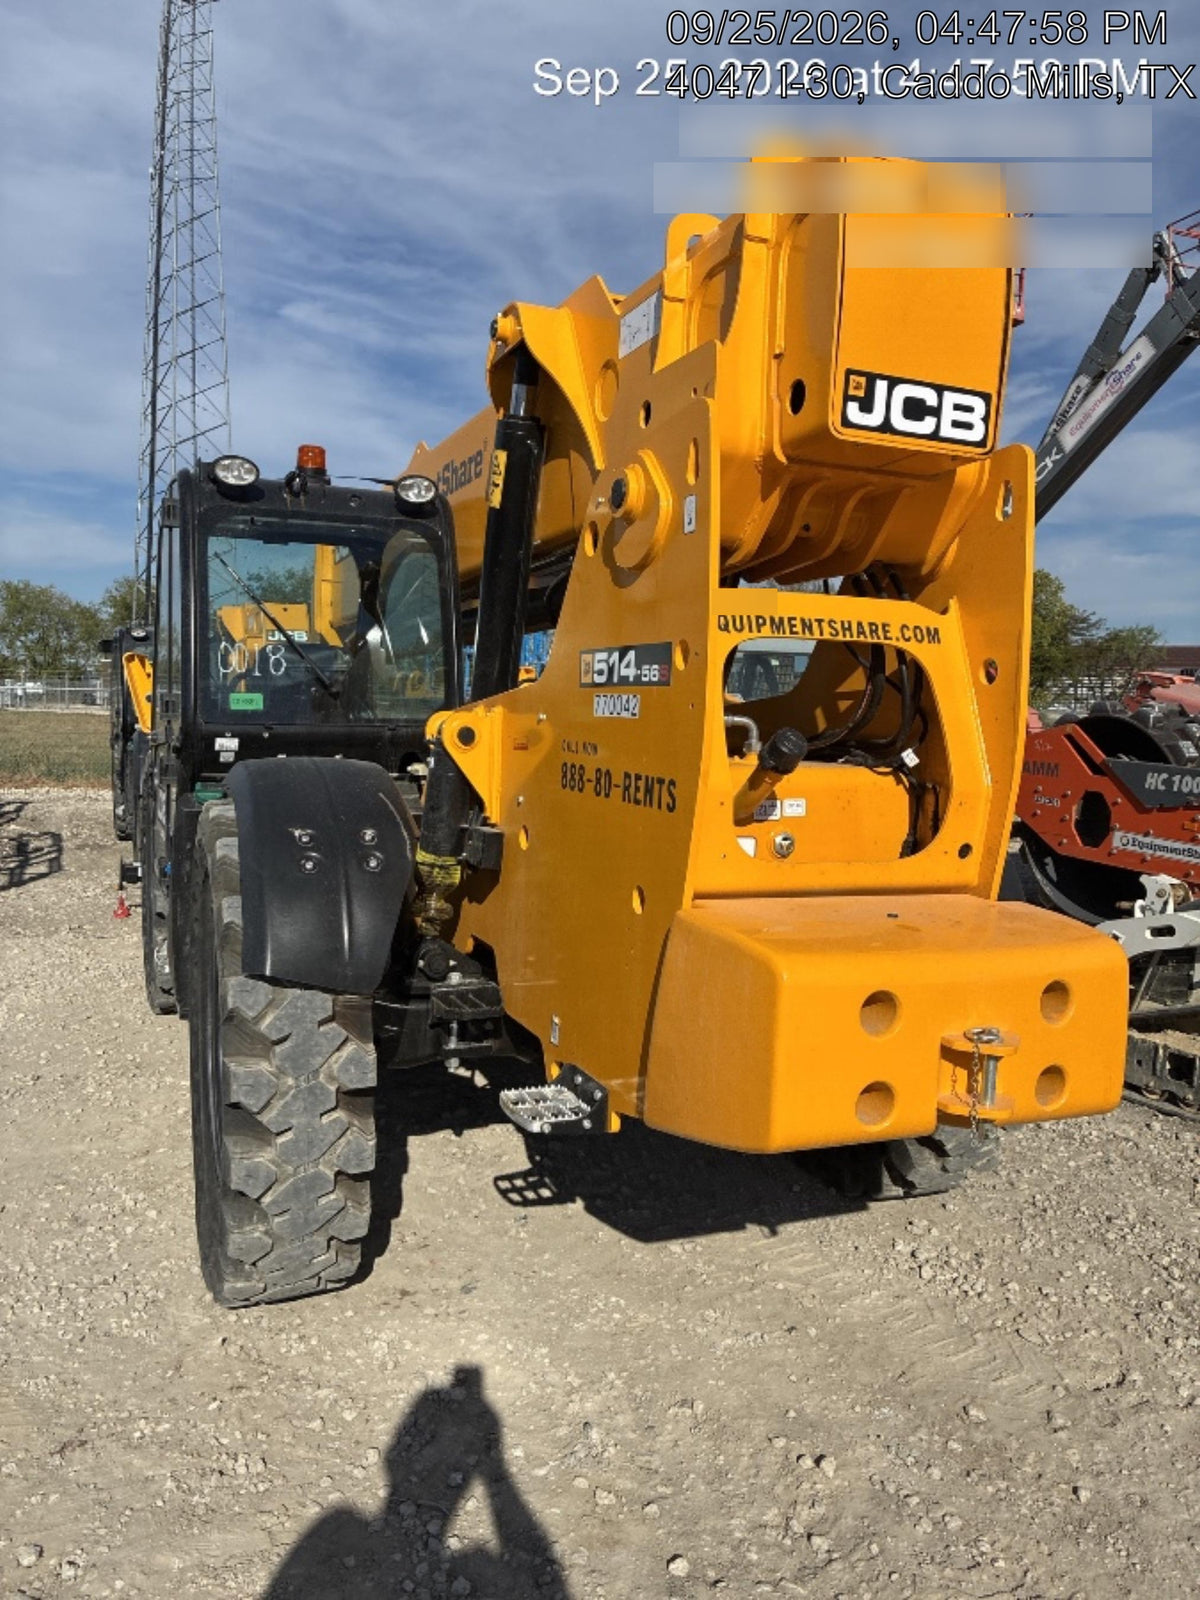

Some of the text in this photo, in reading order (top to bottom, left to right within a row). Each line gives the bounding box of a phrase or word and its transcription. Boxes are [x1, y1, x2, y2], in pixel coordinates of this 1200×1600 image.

[846, 378, 986, 442] JCB
[595, 694, 638, 717] 770042
[561, 762, 677, 813] 888-80-RENTS
[1145, 772, 1167, 791] HC
